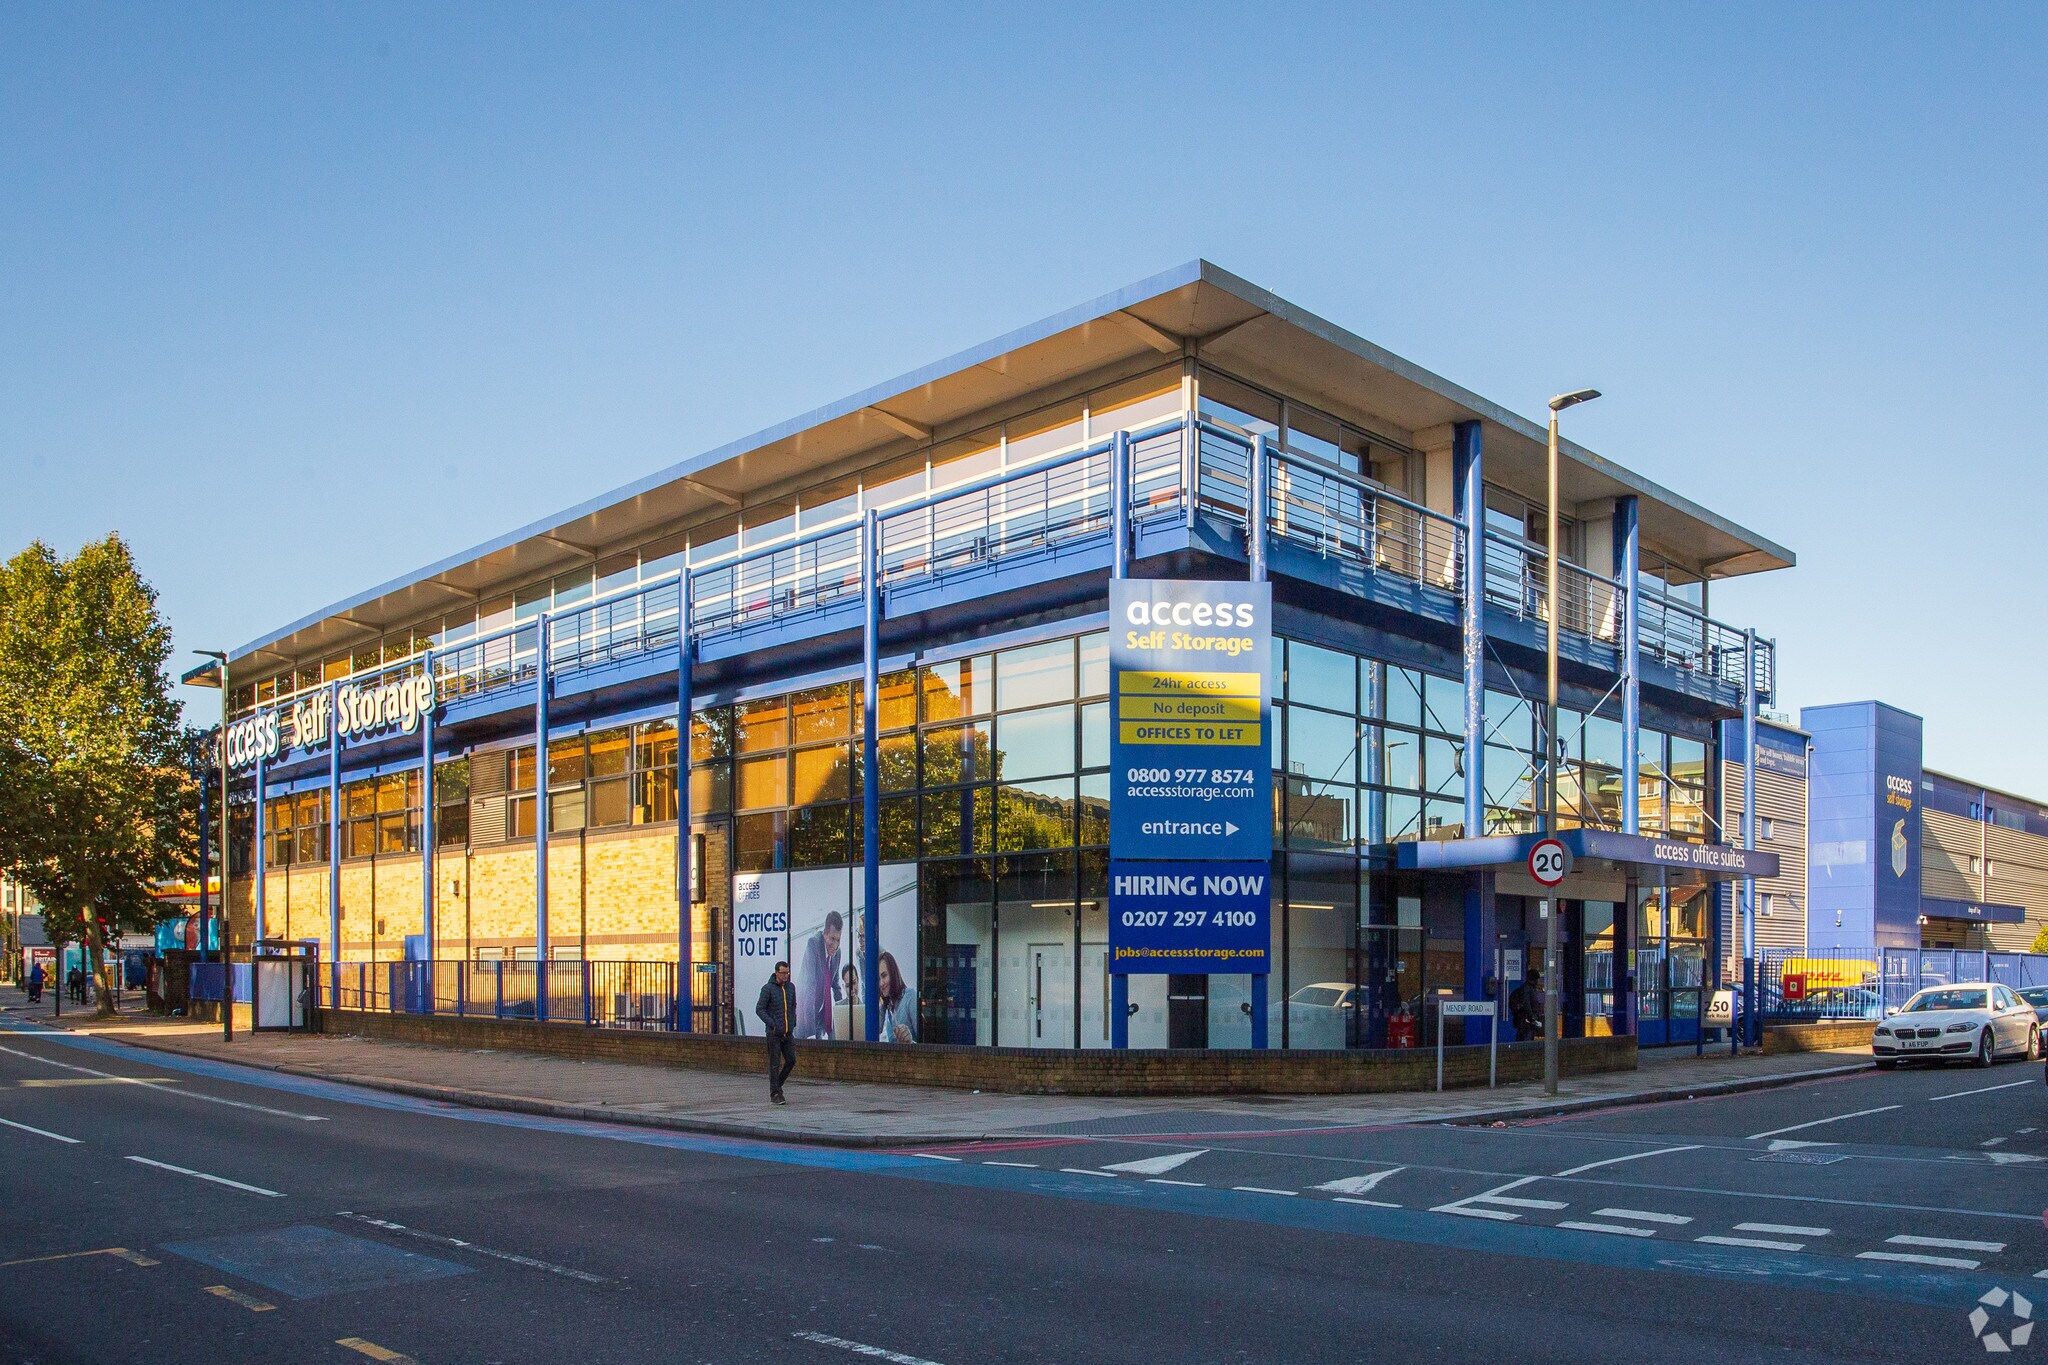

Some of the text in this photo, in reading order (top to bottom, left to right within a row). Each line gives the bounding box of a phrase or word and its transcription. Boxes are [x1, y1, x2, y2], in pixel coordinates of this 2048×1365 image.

[1127, 601, 1254, 628] access
[1126, 631, 1253, 656] Self Storage
[1152, 676, 1227, 689] 24hr access
[292, 690, 330, 749] Self
[337, 673, 436, 736] Storage
[1154, 702, 1225, 717] No deposit
[1136, 727, 1243, 740] OFFICES TO LET
[1127, 768, 1254, 784] 0800 977 8574
[1887, 775, 1912, 794] access
[1127, 785, 1254, 801] accessstorage.com
[1887, 790, 1912, 812] self storage
[1141, 819, 1222, 835] entrance
[1536, 853, 1563, 872] 20
[1654, 843, 1745, 869] access office suites
[738, 881, 760, 891] access
[1114, 875, 1264, 896] HIRING NOW
[738, 912, 787, 933] OFFICES
[1122, 911, 1256, 926] 0207 297 4100
[738, 937, 778, 956] TO LET
[1115, 946, 1265, 960] jobs@accessstorage.com
[1704, 1001, 1729, 1012] 250
